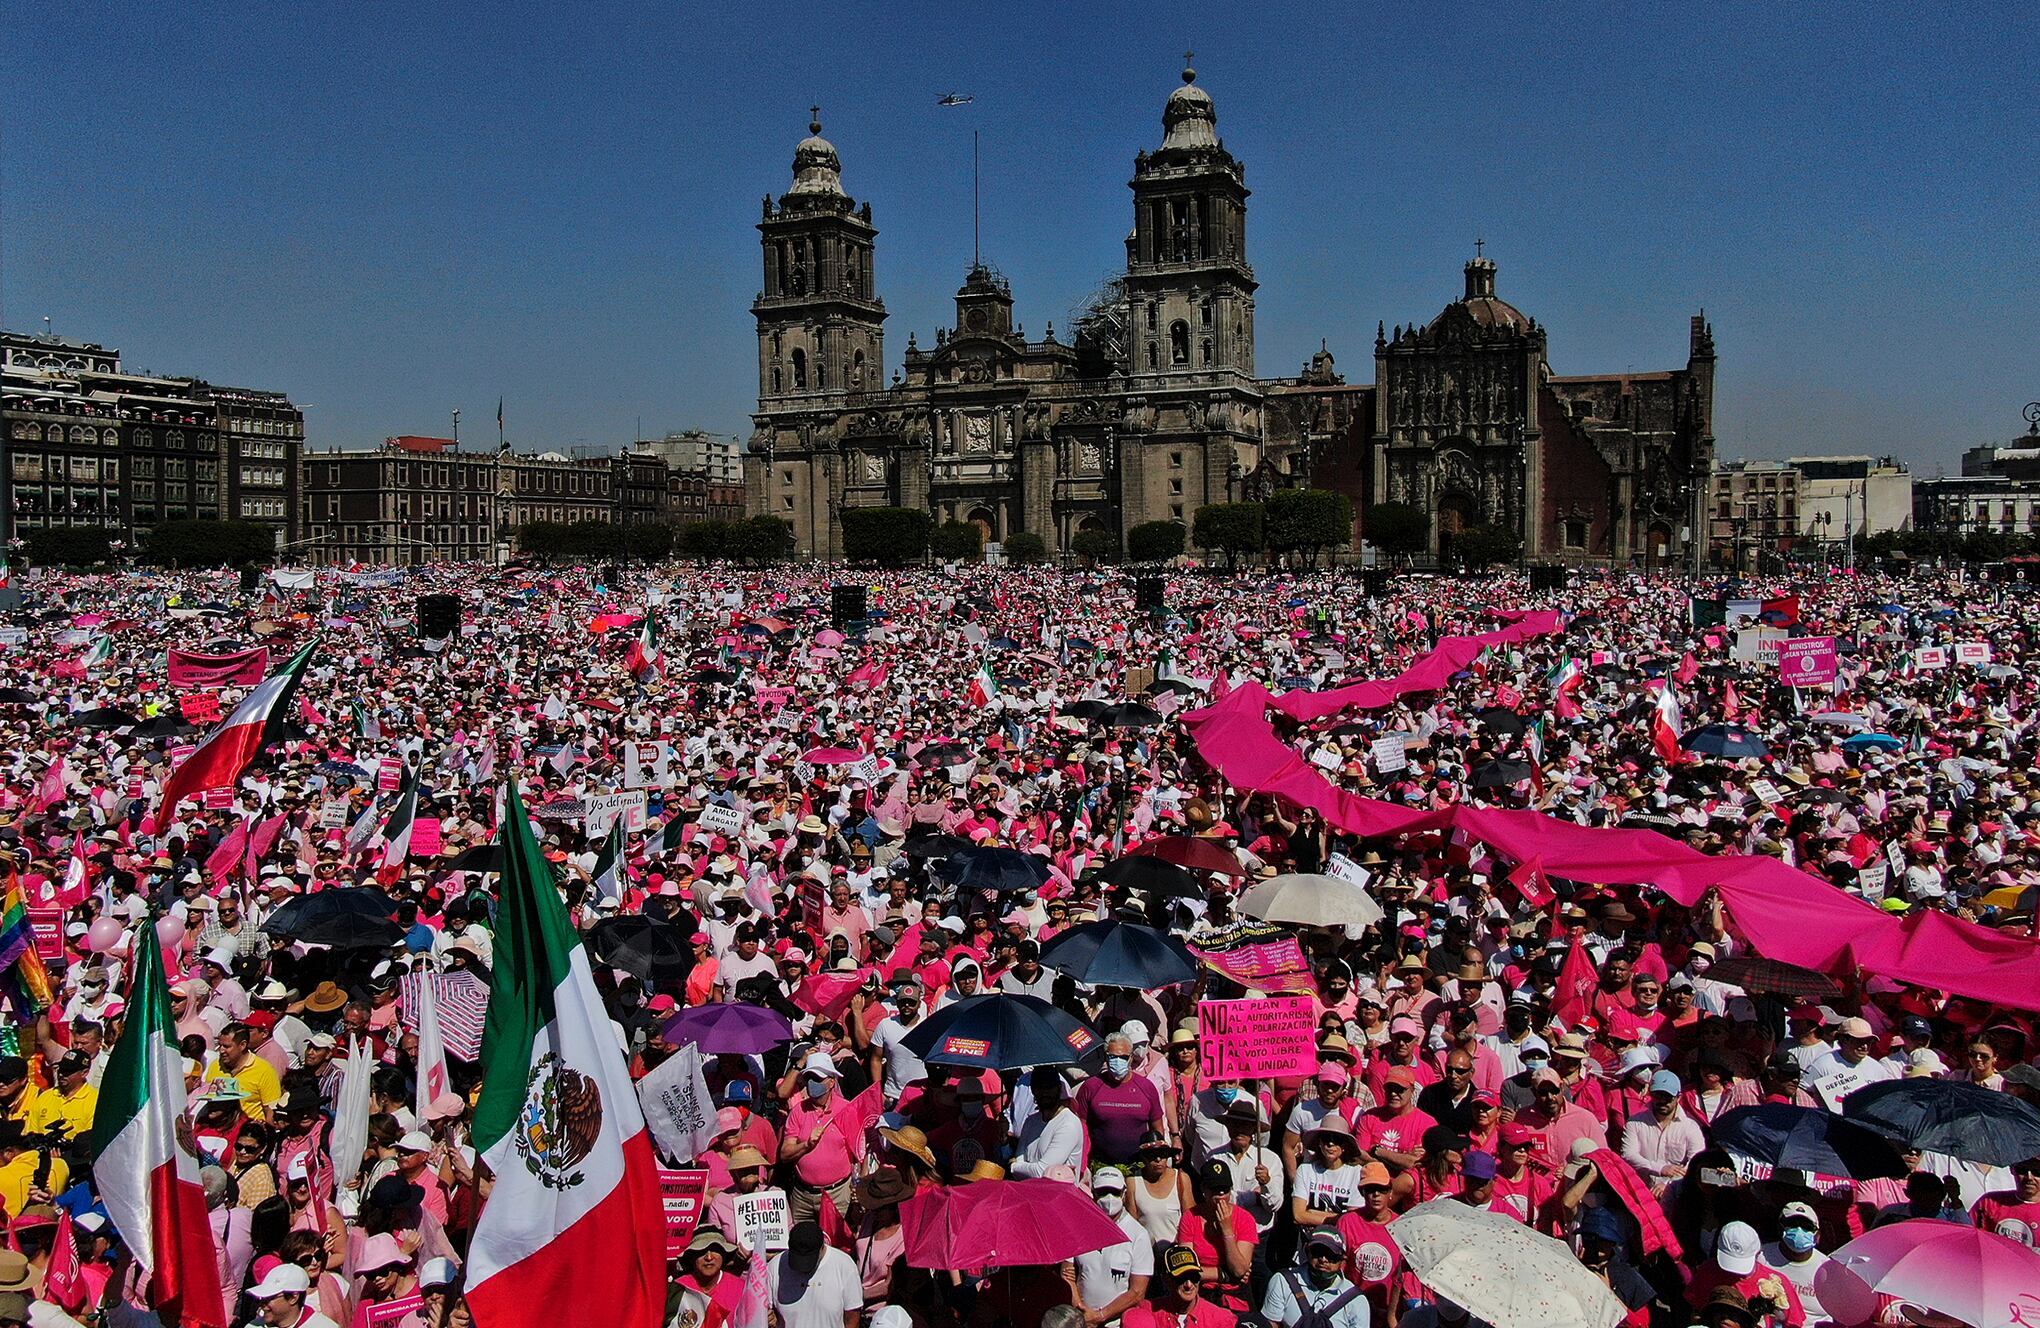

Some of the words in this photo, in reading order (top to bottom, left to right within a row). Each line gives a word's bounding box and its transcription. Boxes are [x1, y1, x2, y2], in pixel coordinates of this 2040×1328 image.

[1758, 640, 1775, 650] IN
[1789, 641, 1824, 650] MINISTROS
[712, 807, 738, 818] AMLO
[1250, 1002, 1280, 1010] PLAN
[1202, 1004, 1227, 1036] NO
[1247, 1010, 1313, 1021] AUTORITARISMO
[1080, 1036, 1092, 1046] INE
[1253, 1036, 1309, 1046] DEMOCRACIA
[959, 1047, 985, 1056] INE
[1246, 1049, 1267, 1057] VOTO
[1272, 1046, 1302, 1055] LIBRE
[1227, 1063, 1234, 1072] A
[1238, 1062, 1250, 1072] LA
[1258, 1058, 1297, 1071] UNIDAD
[1825, 1074, 1858, 1090] DEFIENDO
[1334, 1186, 1350, 1195] nos
